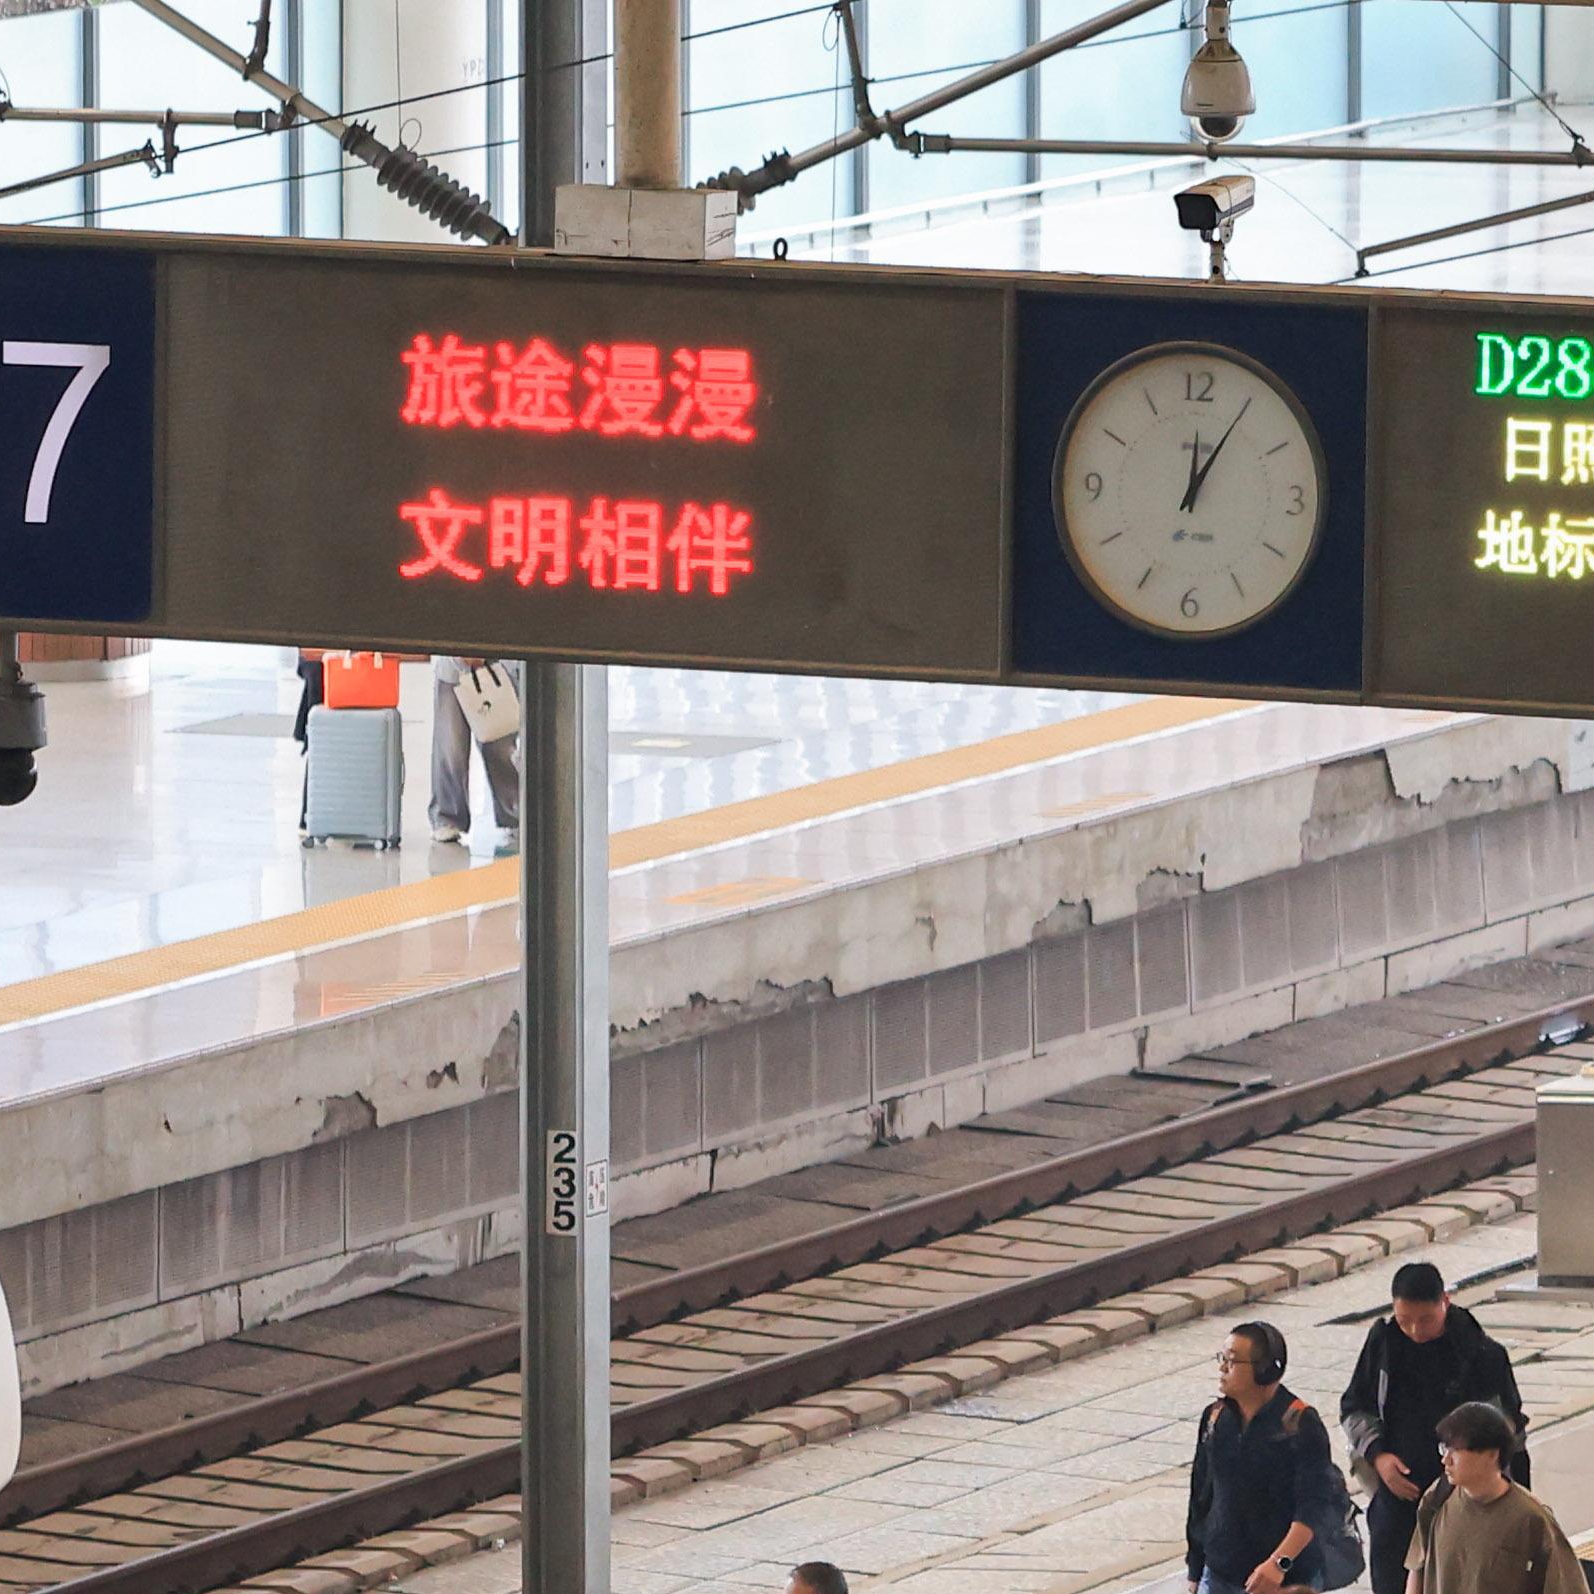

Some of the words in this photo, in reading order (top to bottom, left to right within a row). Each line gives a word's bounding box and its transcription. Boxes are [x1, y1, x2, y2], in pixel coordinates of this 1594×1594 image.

[401, 334, 758, 444] 旅途漫漫
[1183, 371, 1215, 402] 12
[1084, 472, 1103, 502] 9
[1285, 485, 1305, 516] 3
[400, 488, 755, 596] 文明相伴
[1179, 587, 1199, 618] 6
[552, 1133, 577, 1232] 235
